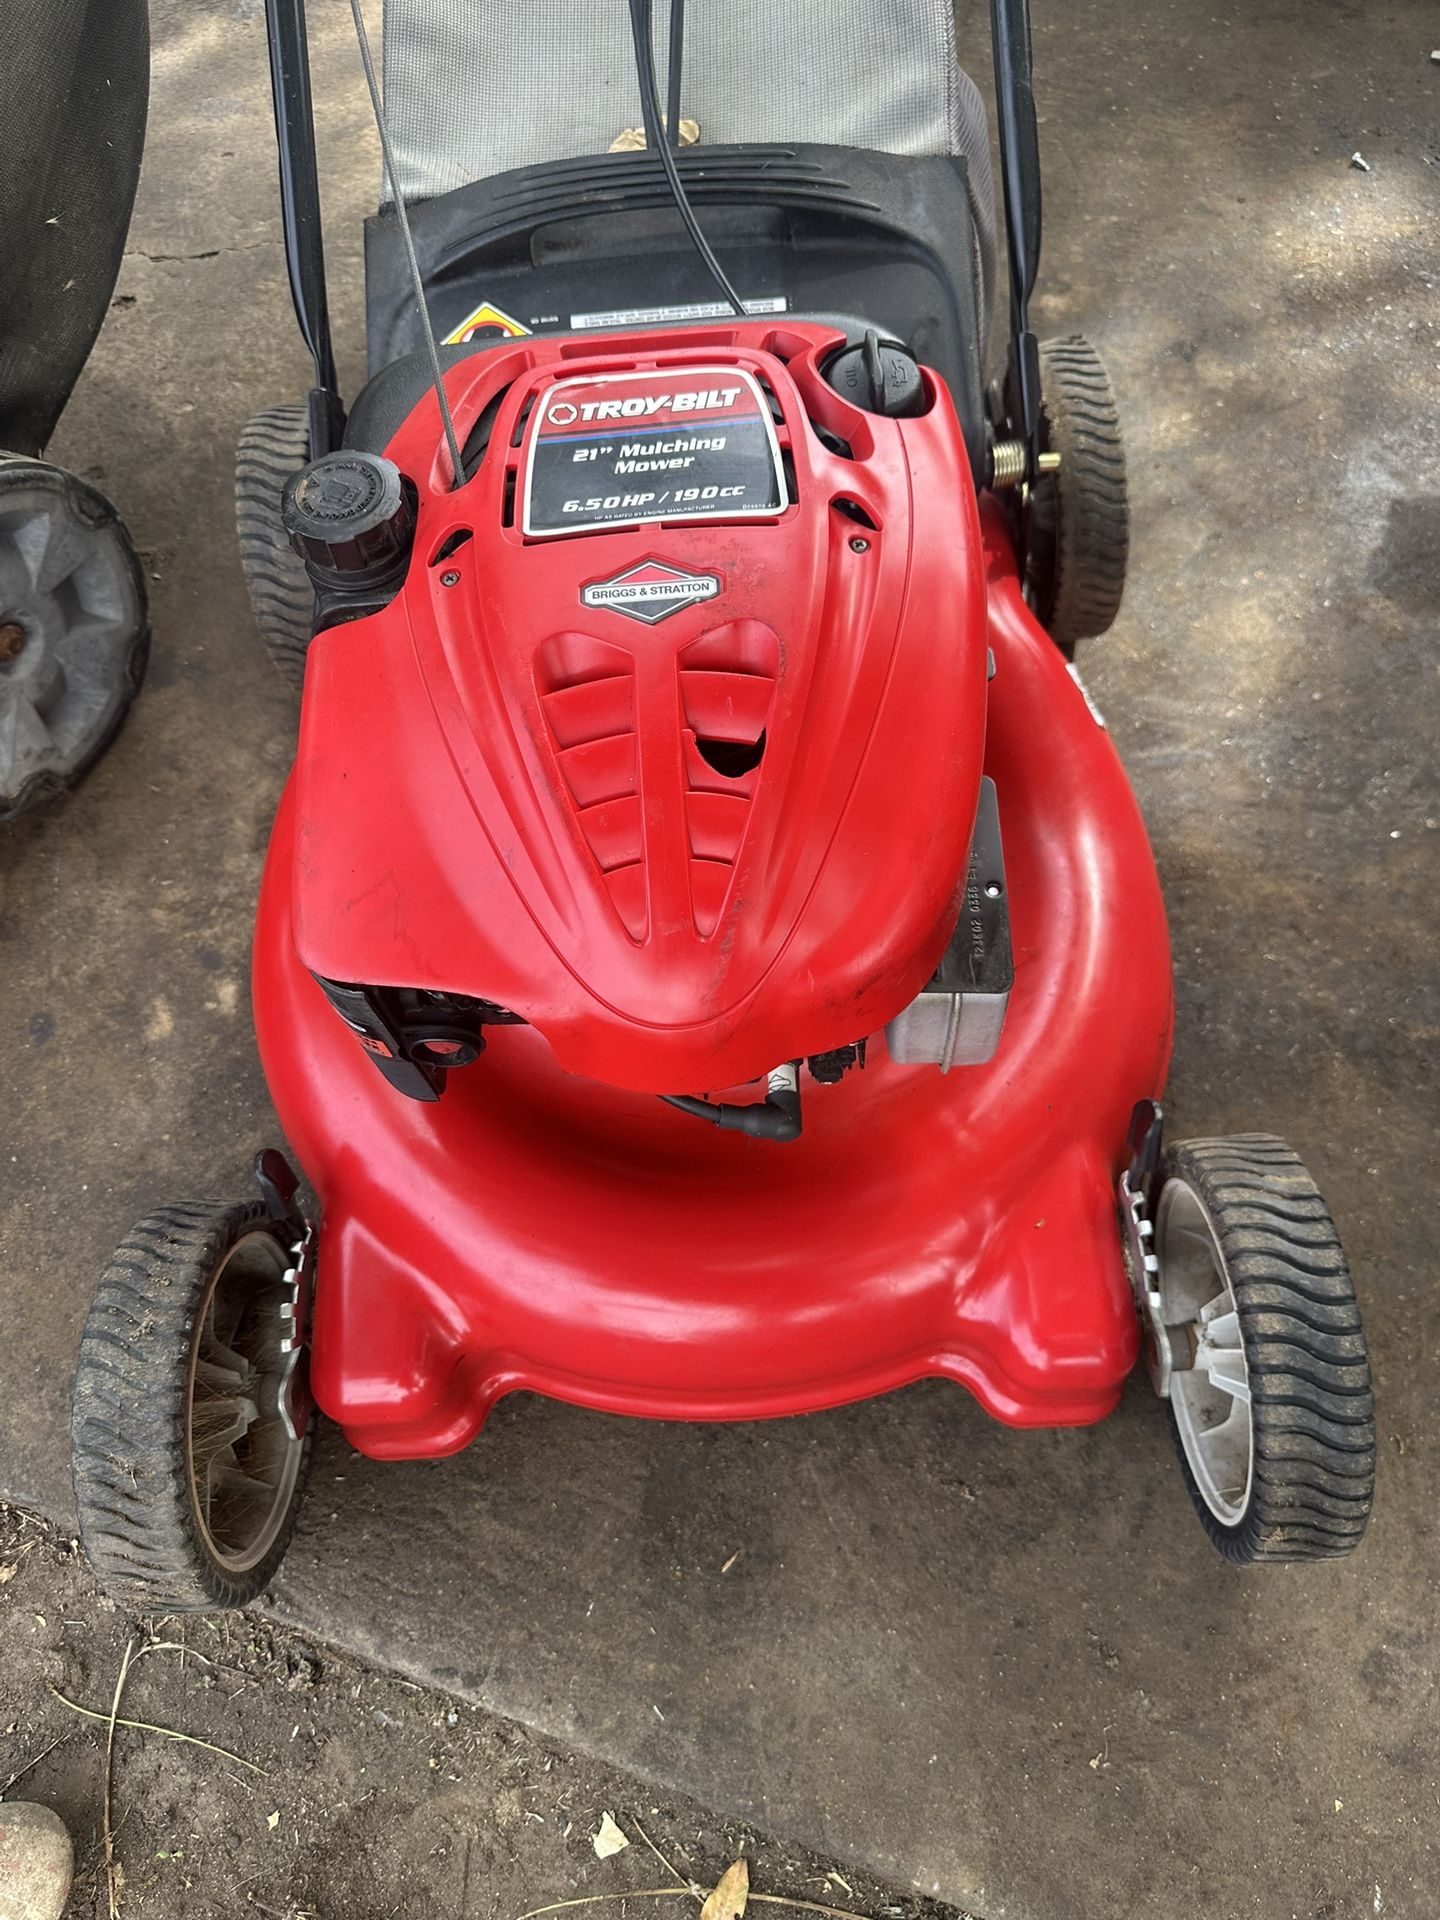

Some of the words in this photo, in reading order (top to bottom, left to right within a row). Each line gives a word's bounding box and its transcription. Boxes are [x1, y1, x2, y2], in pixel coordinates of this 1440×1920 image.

[579, 387, 742, 422] TROY-BILT
[619, 436, 726, 458] Mulching
[614, 456, 695, 475] Mower
[613, 511, 633, 519] RATED
[643, 508, 666, 517] ENGINE
[667, 504, 715, 514] MANUFACTURER
[592, 588, 636, 600] BRIGGS
[639, 587, 648, 597] &
[649, 582, 710, 595] STRATTON
